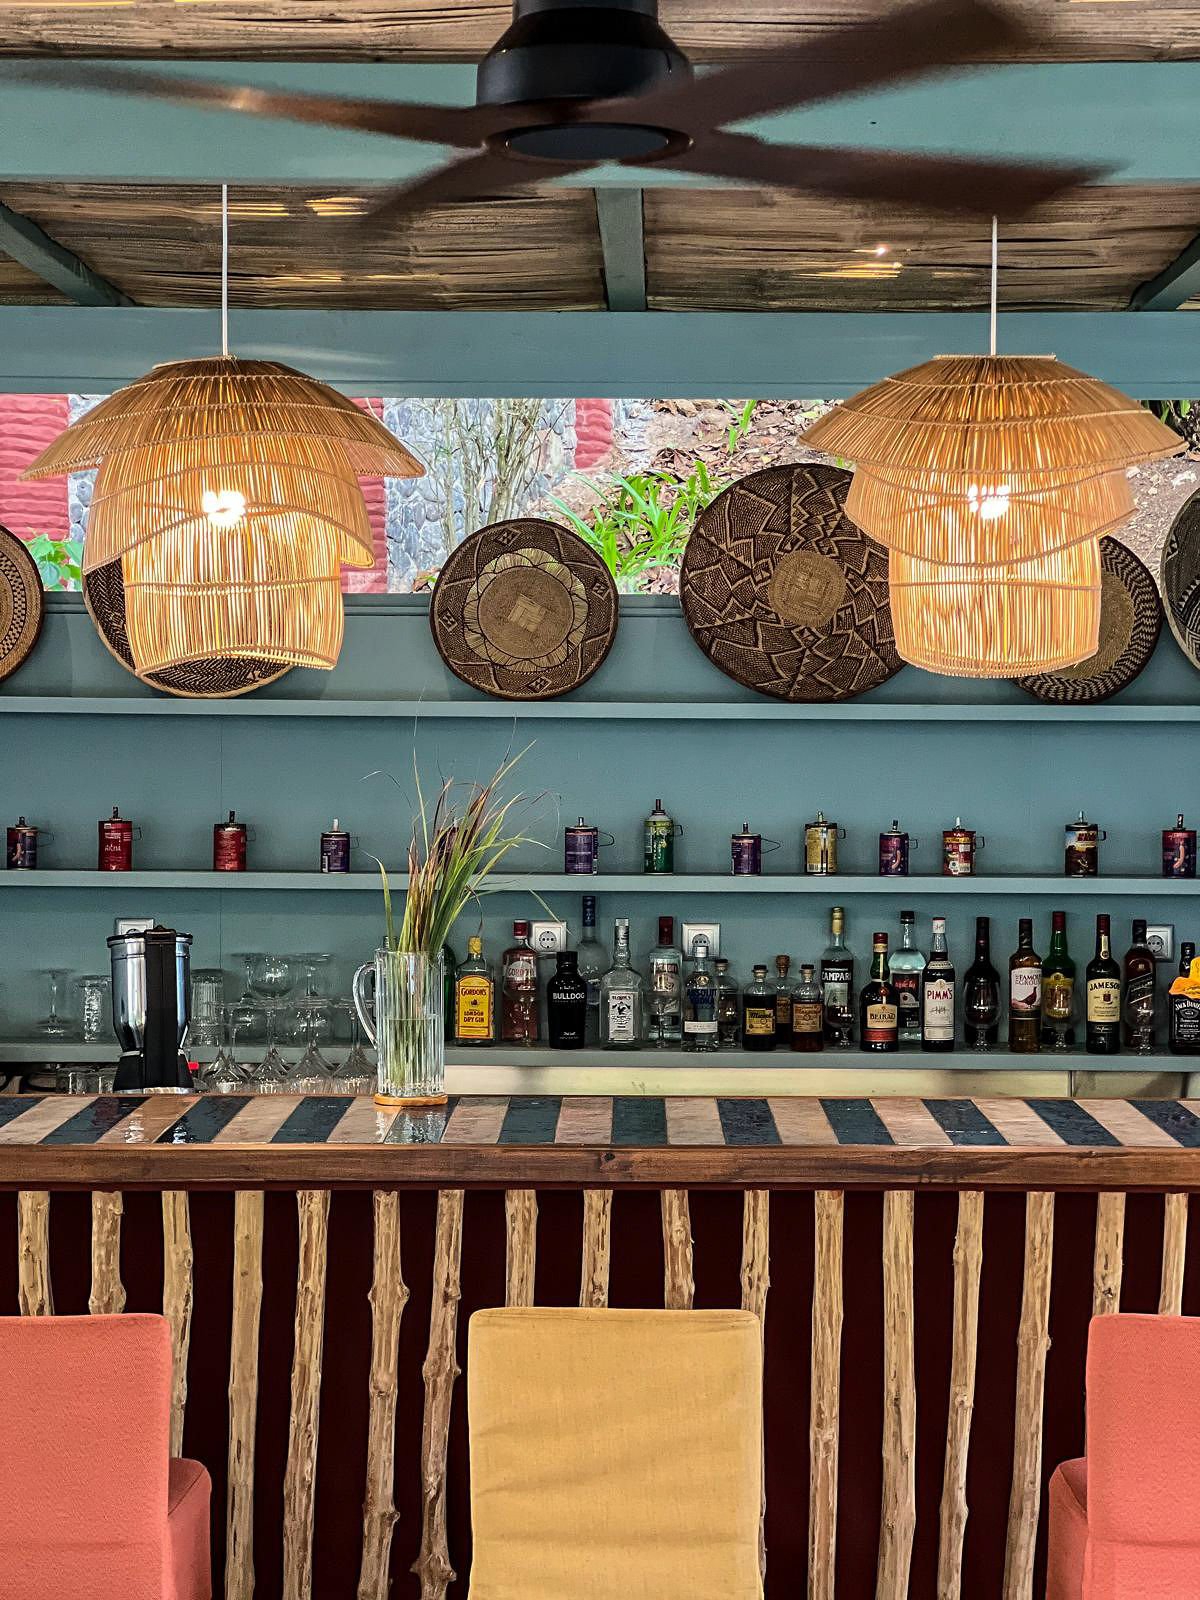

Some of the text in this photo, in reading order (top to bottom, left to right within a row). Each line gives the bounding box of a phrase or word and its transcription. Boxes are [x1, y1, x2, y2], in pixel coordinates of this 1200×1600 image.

[460, 987, 487, 997] GORDON'S
[552, 992, 585, 1000] BULLDOG
[926, 987, 953, 1000] PIMM'S
